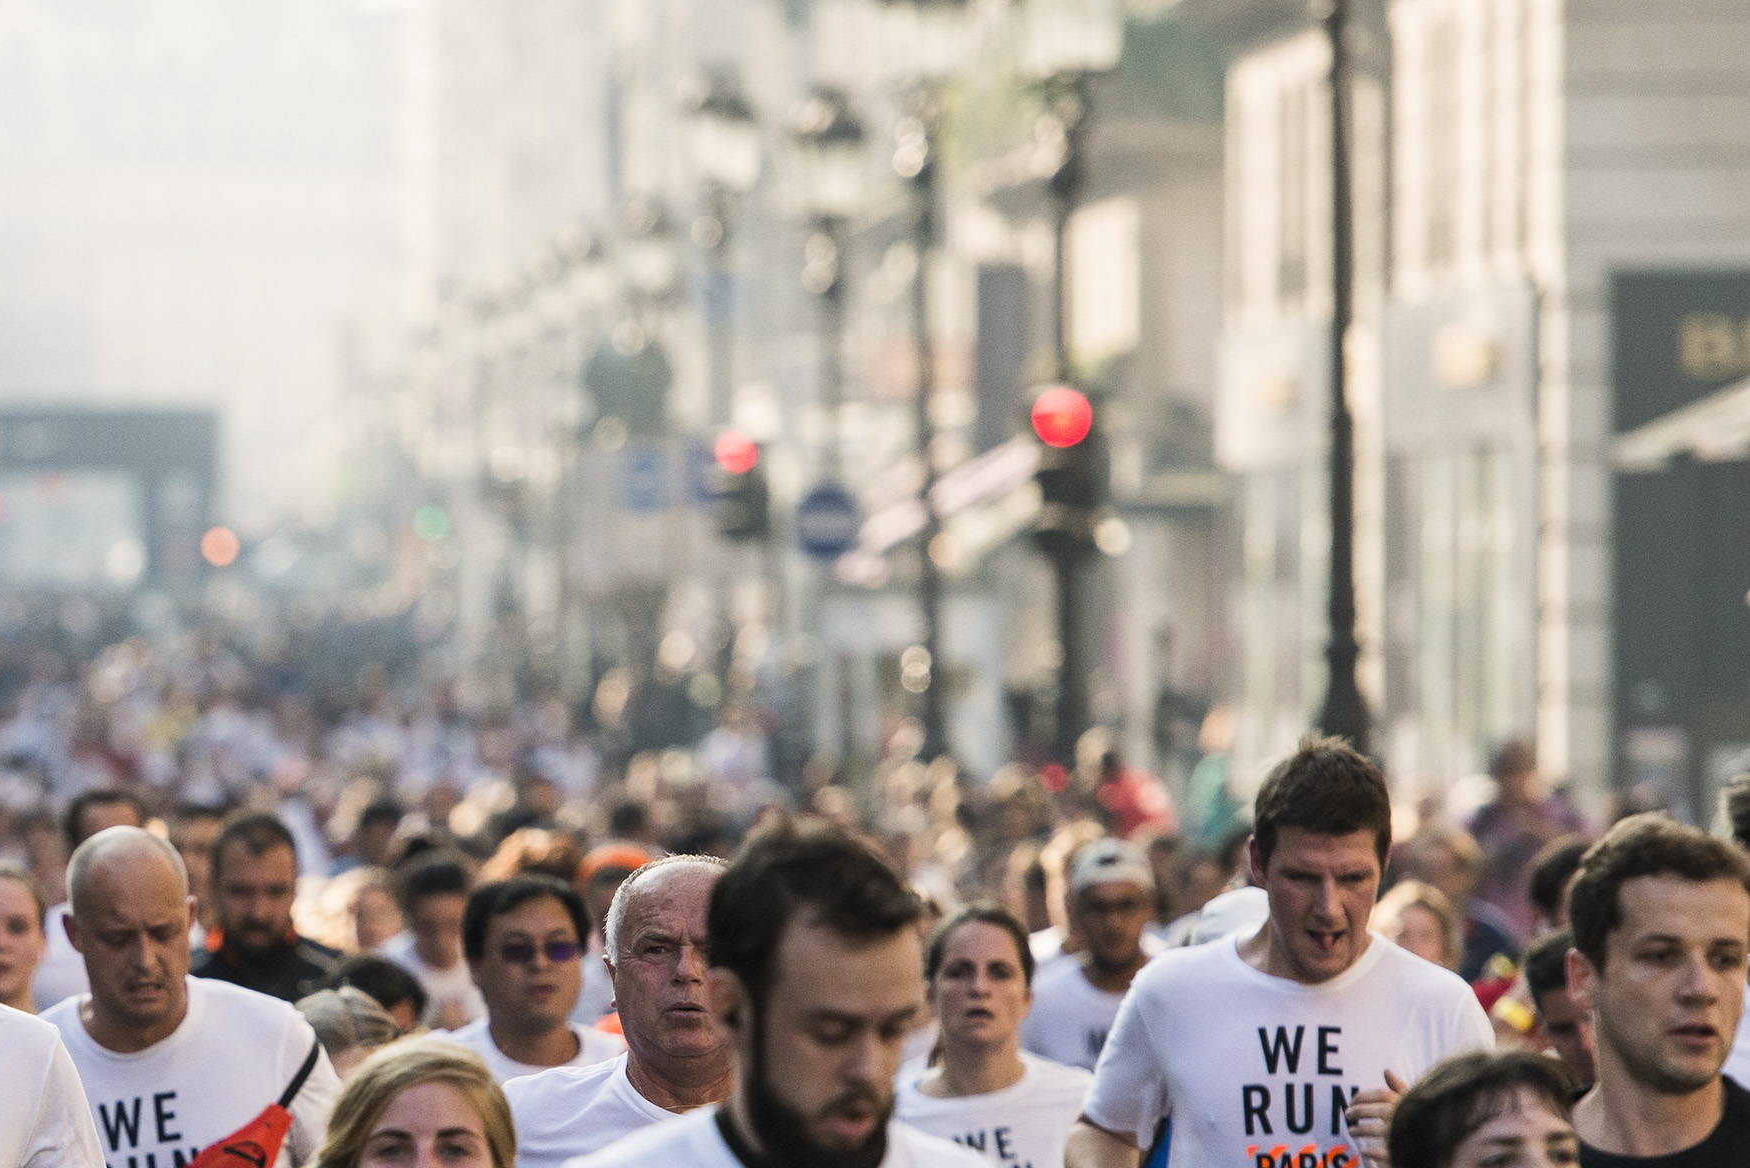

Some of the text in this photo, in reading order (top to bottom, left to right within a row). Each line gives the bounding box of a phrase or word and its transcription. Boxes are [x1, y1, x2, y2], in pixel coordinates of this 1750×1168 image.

[1257, 1025, 1343, 1075] WE
[98, 1090, 181, 1152] WE
[1242, 1083, 1359, 1136] RUN
